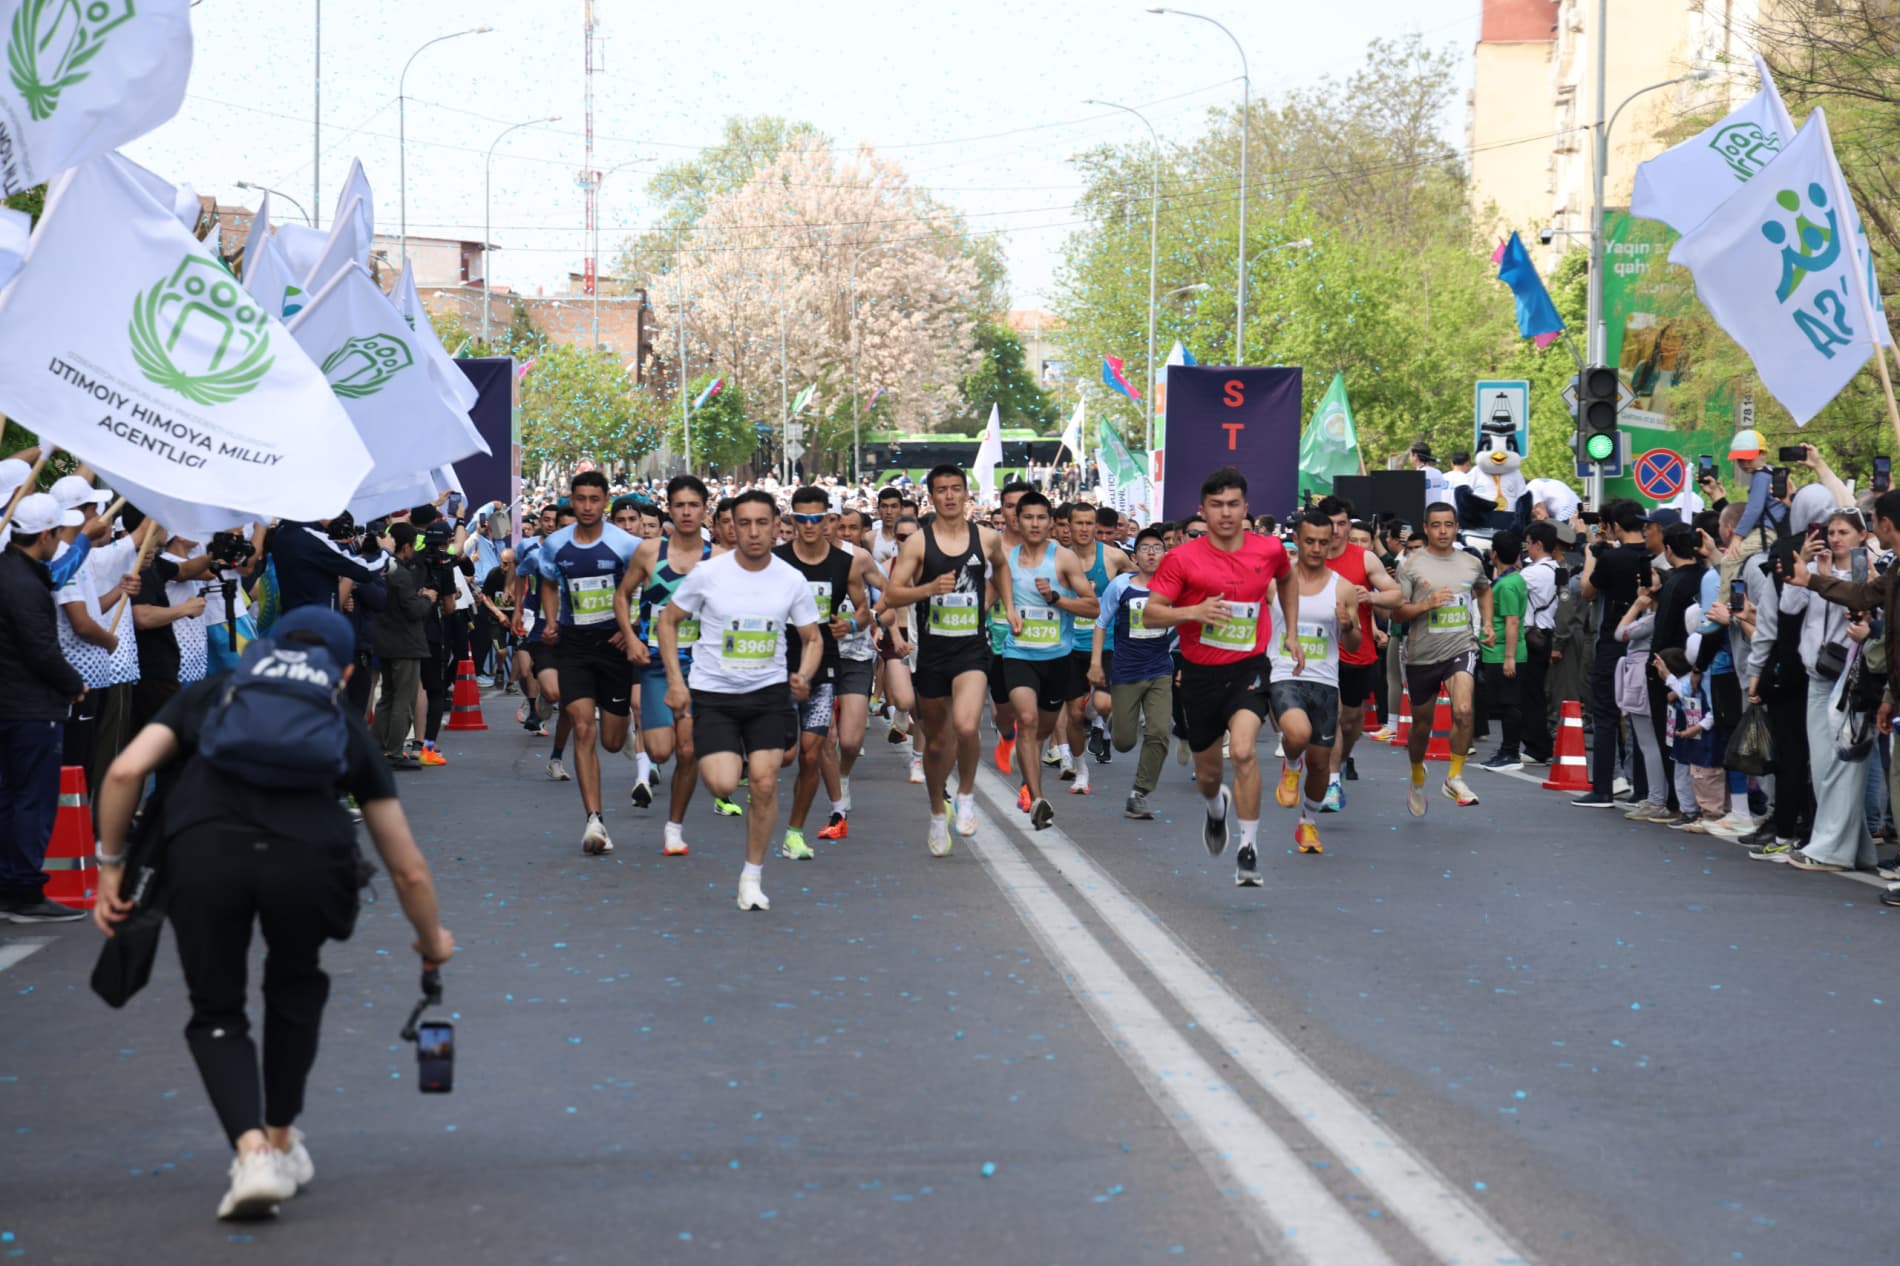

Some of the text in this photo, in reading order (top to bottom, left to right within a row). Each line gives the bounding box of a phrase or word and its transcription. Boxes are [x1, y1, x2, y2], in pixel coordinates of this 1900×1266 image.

[1604, 240, 1650, 257] Yaqin
[1792, 275, 1854, 360] AS
[48, 357, 130, 409] IJTIMOIY
[130, 403, 212, 452] HIMOYA
[217, 442, 284, 467] MILLIY
[1743, 408, 1753, 423] 78
[97, 415, 207, 469] AGENTLIGI
[942, 612, 976, 626] 4844
[677, 626, 697, 638] 87
[1024, 626, 1058, 639] 4379
[1217, 624, 1255, 639] 7237
[736, 639, 776, 653] 3968
